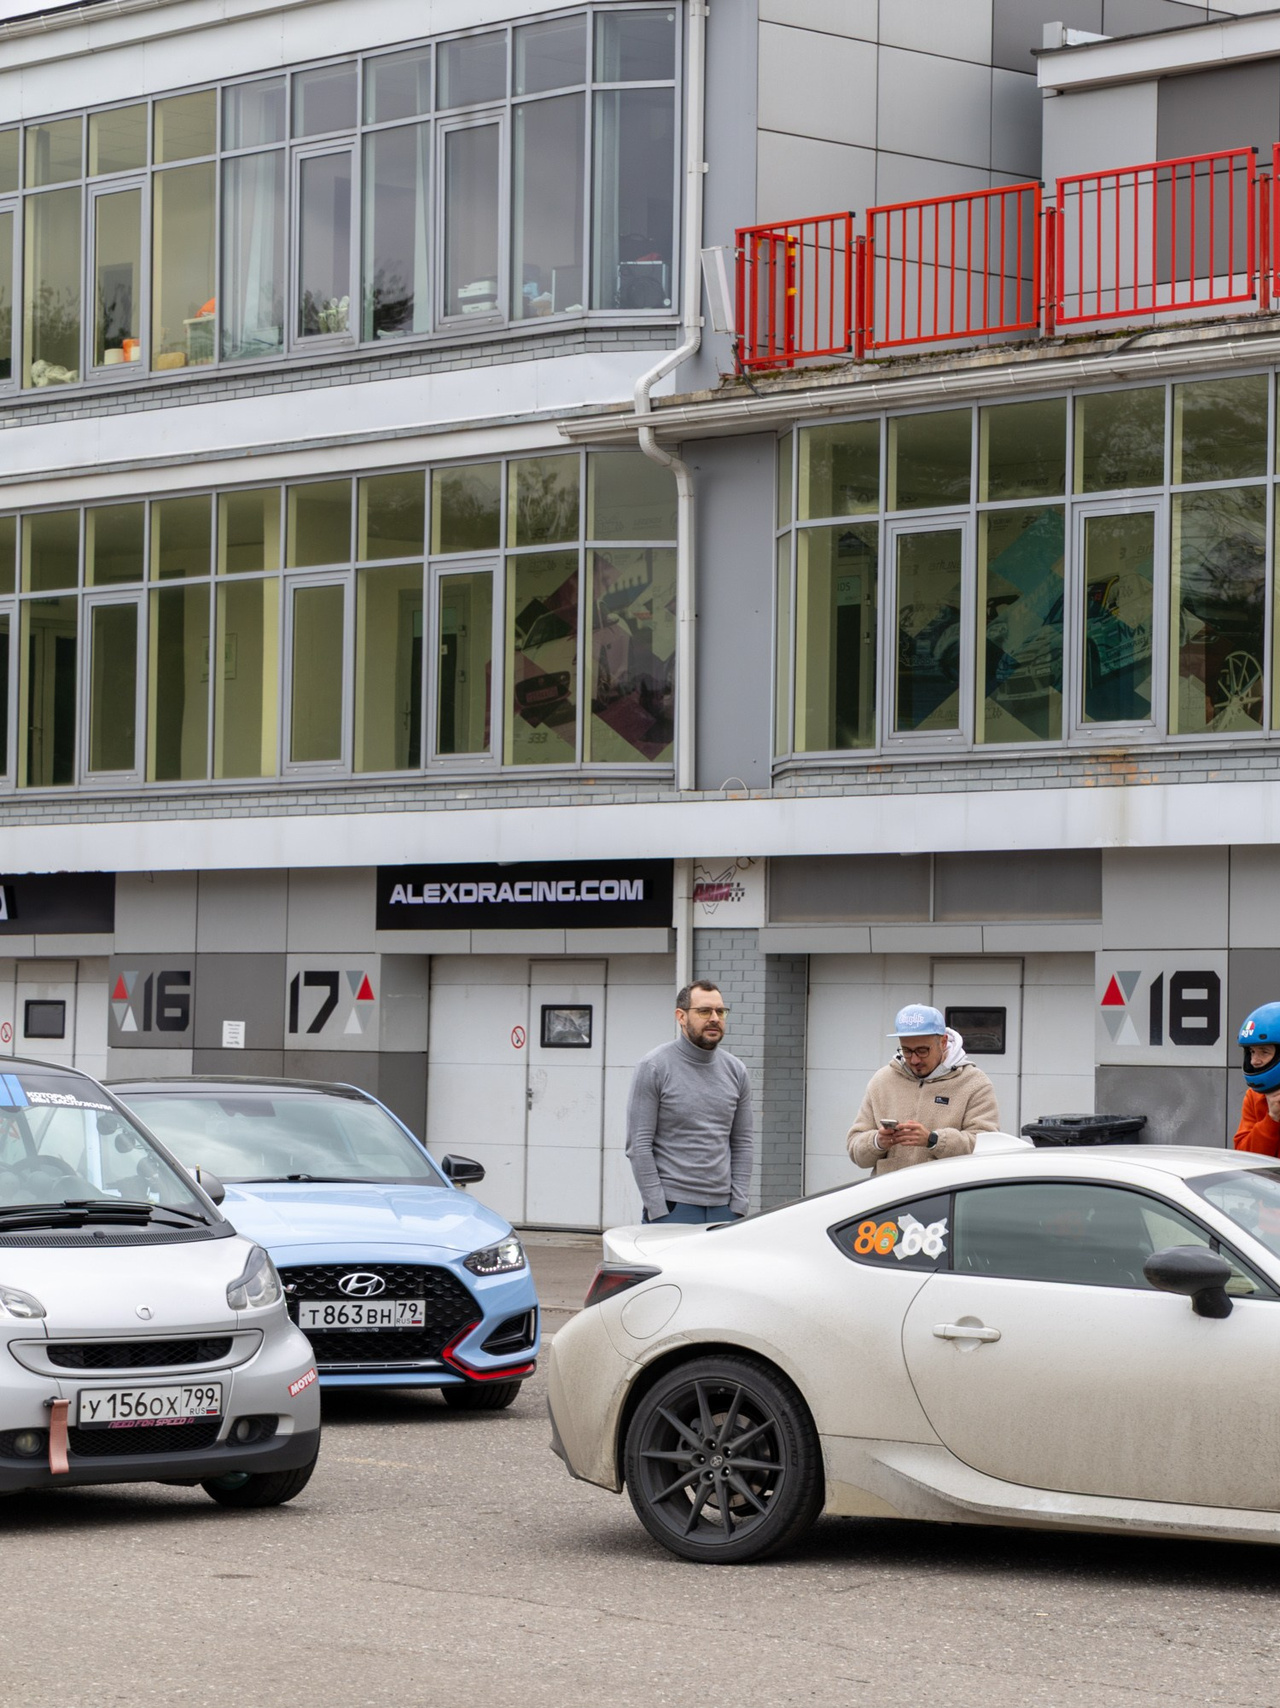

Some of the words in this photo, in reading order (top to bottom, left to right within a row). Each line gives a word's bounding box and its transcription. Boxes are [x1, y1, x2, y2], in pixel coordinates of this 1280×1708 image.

[389, 880, 644, 904] ALEXDRACING.COM
[143, 971, 190, 1031] 16
[289, 971, 339, 1033] 17
[1150, 970, 1220, 1046] 18
[854, 1221, 897, 1255] 86
[902, 1222, 944, 1256] 68
[398, 1303, 418, 1318] 79
[290, 1369, 316, 1396] MOTUL
[183, 1388, 215, 1408] 799
[108, 1421, 134, 1429] NEED
[155, 1418, 187, 1427] SPEED
[189, 1407, 206, 1415] RUS
